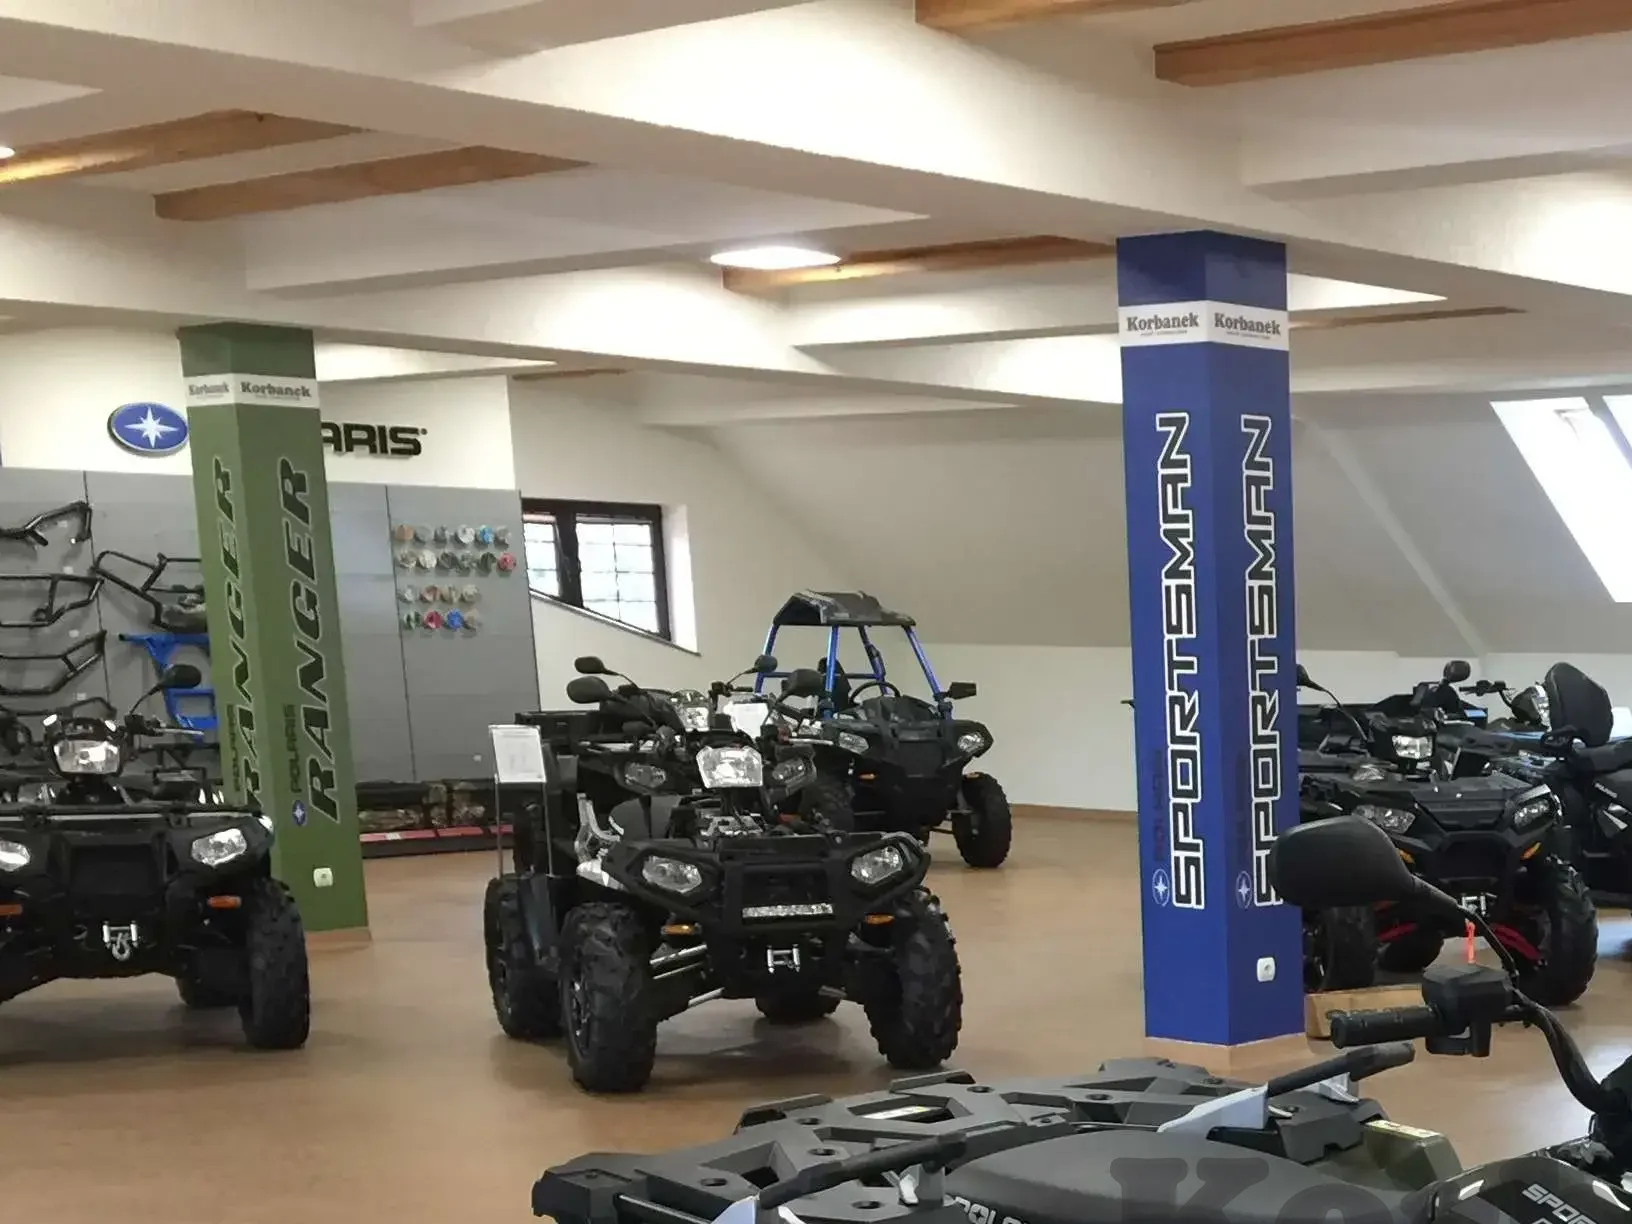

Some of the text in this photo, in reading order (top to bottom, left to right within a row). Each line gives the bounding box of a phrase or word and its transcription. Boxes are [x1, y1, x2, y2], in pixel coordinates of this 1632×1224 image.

[1126, 312, 1200, 332] Korbanek
[1213, 312, 1281, 336] Korbanek
[240, 381, 312, 398] Korbanek
[321, 422, 422, 456] ARIS
[277, 455, 341, 824] RANGER
[1155, 411, 1205, 910] SPORTSMAN
